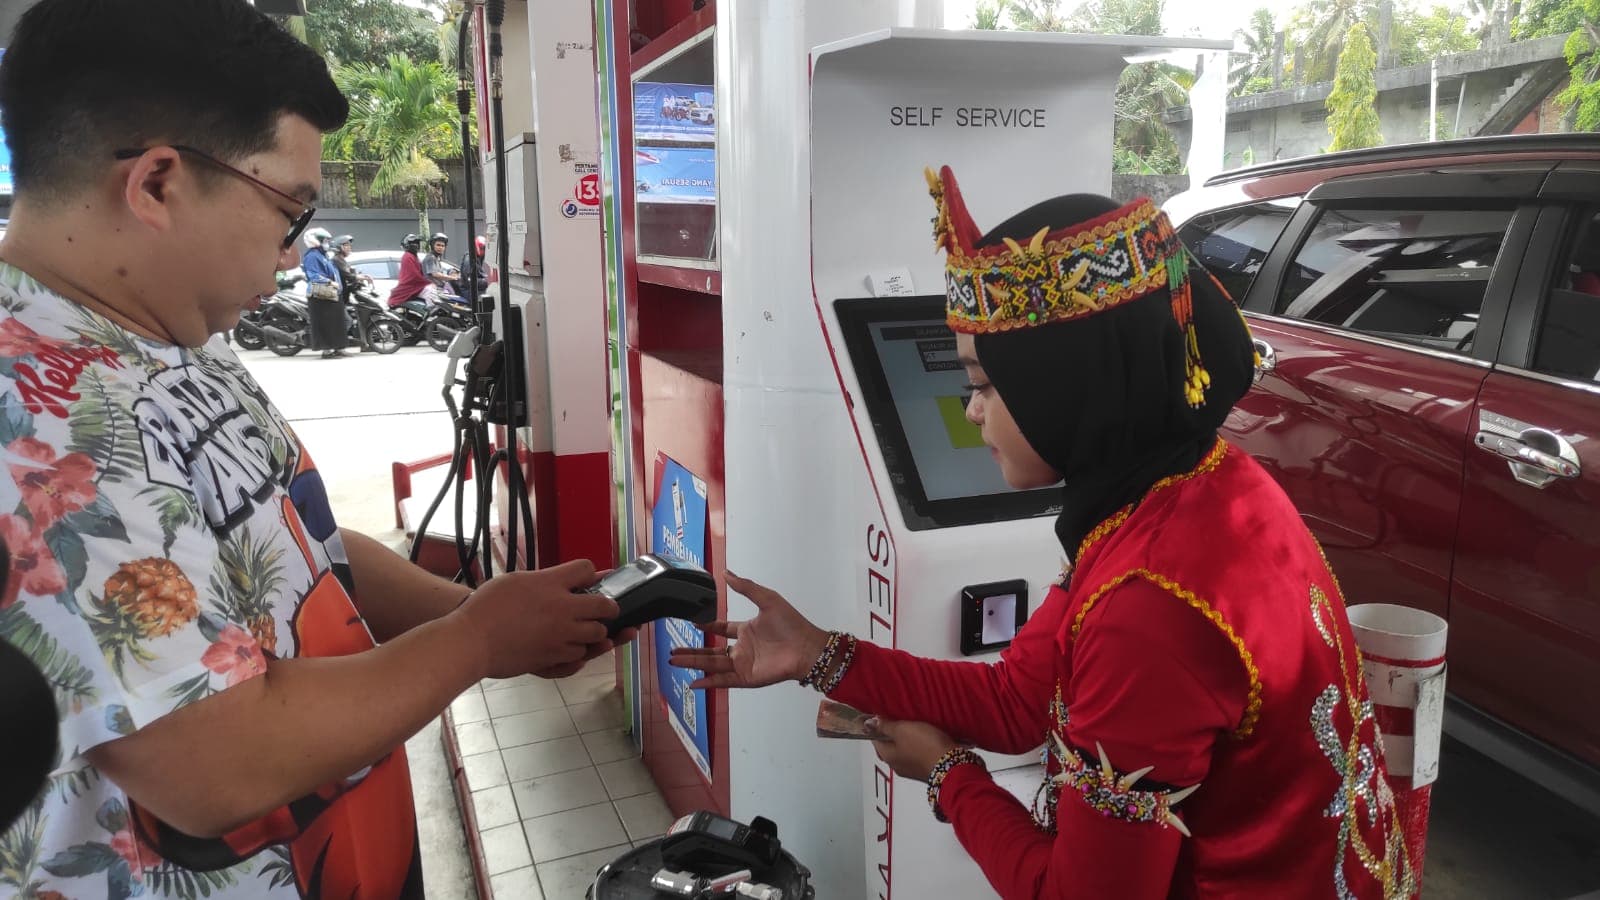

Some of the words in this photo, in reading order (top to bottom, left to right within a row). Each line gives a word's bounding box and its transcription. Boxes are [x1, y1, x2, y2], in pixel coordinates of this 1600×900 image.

[890, 106, 943, 126] SELF
[956, 107, 1046, 128] SERVICE
[576, 179, 600, 200] 13
[867, 523, 892, 640] SEL
